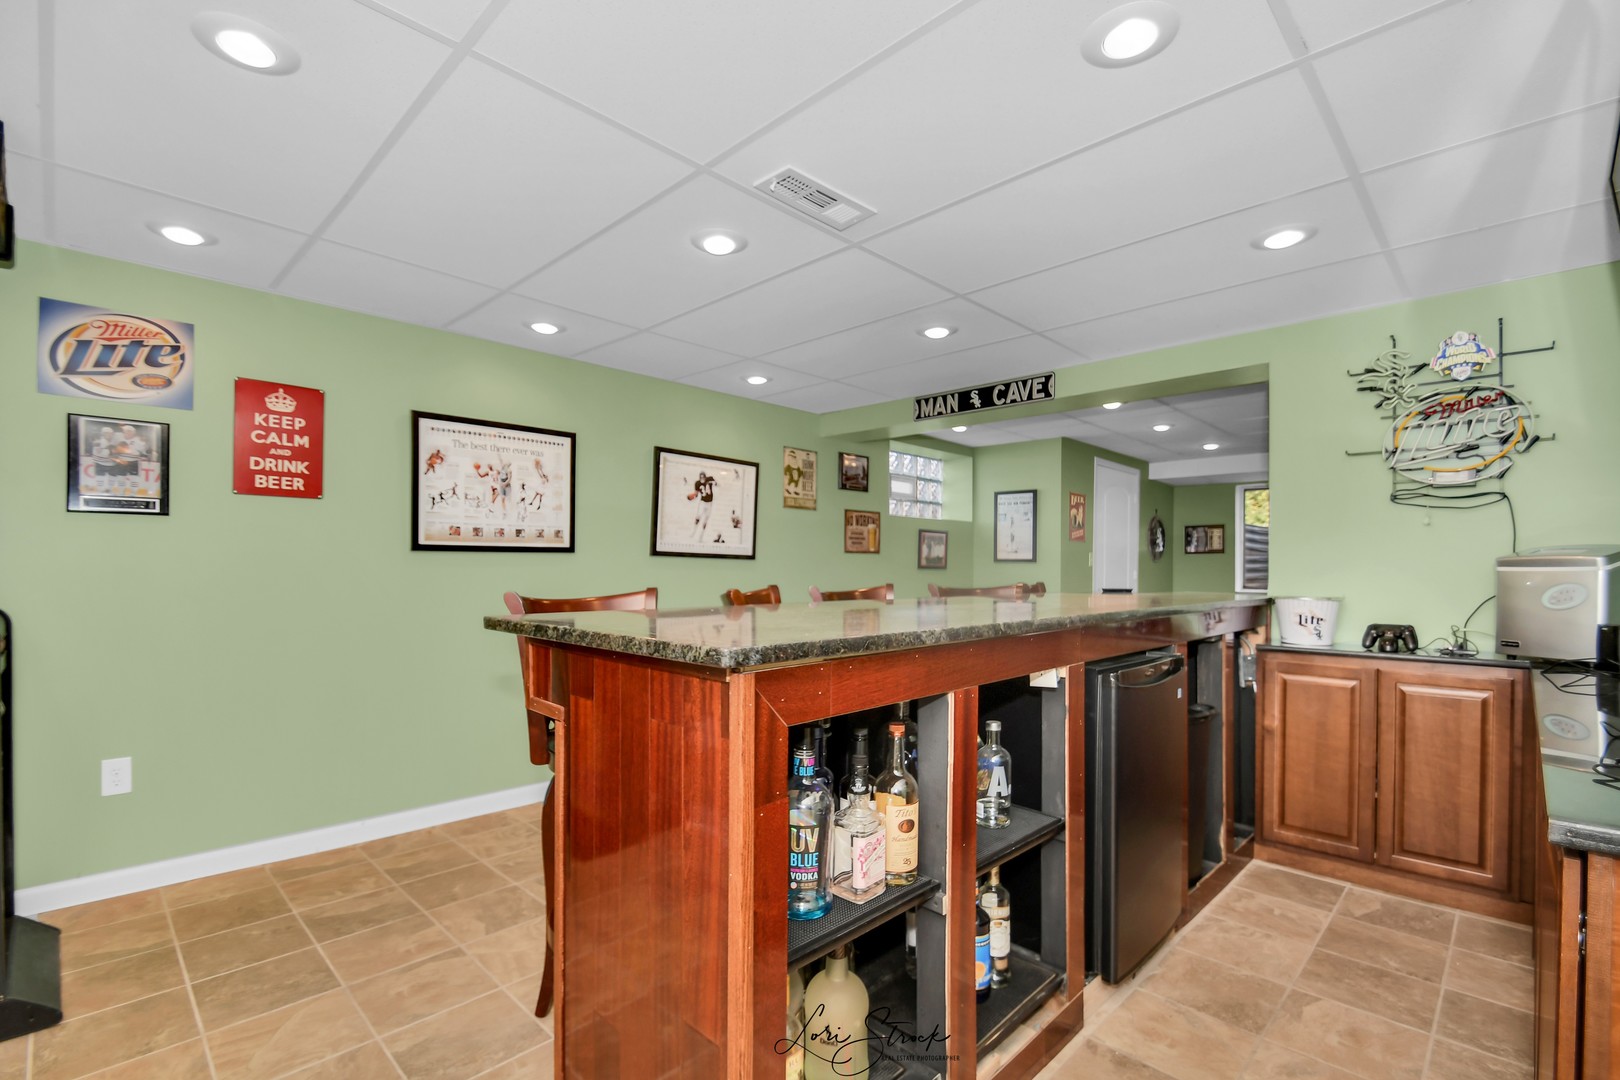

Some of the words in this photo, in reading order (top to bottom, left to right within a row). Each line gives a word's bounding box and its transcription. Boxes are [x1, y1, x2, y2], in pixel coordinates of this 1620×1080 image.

[90, 320, 165, 338] Miller
[60, 339, 183, 376] Lite
[1445, 343, 1477, 356] WORLD
[920, 393, 959, 418] MAN
[992, 377, 1045, 405] CAVE
[1424, 391, 1505, 419] Miller
[254, 413, 306, 430] KEEP
[250, 430, 310, 448] CALM
[1391, 405, 1521, 469] Lite
[269, 448, 292, 456] AND
[452, 439, 469, 448] The
[470, 442, 487, 451] best
[490, 444, 511, 453] there
[530, 449, 544, 457] was
[249, 457, 310, 474] DRINK
[254, 475, 305, 491] BEER
[699, 485, 711, 497] 34
[1299, 614, 1324, 627] Lite
[790, 827, 819, 853] UV
[790, 852, 819, 868] BLUE
[790, 872, 818, 880] VODKA
